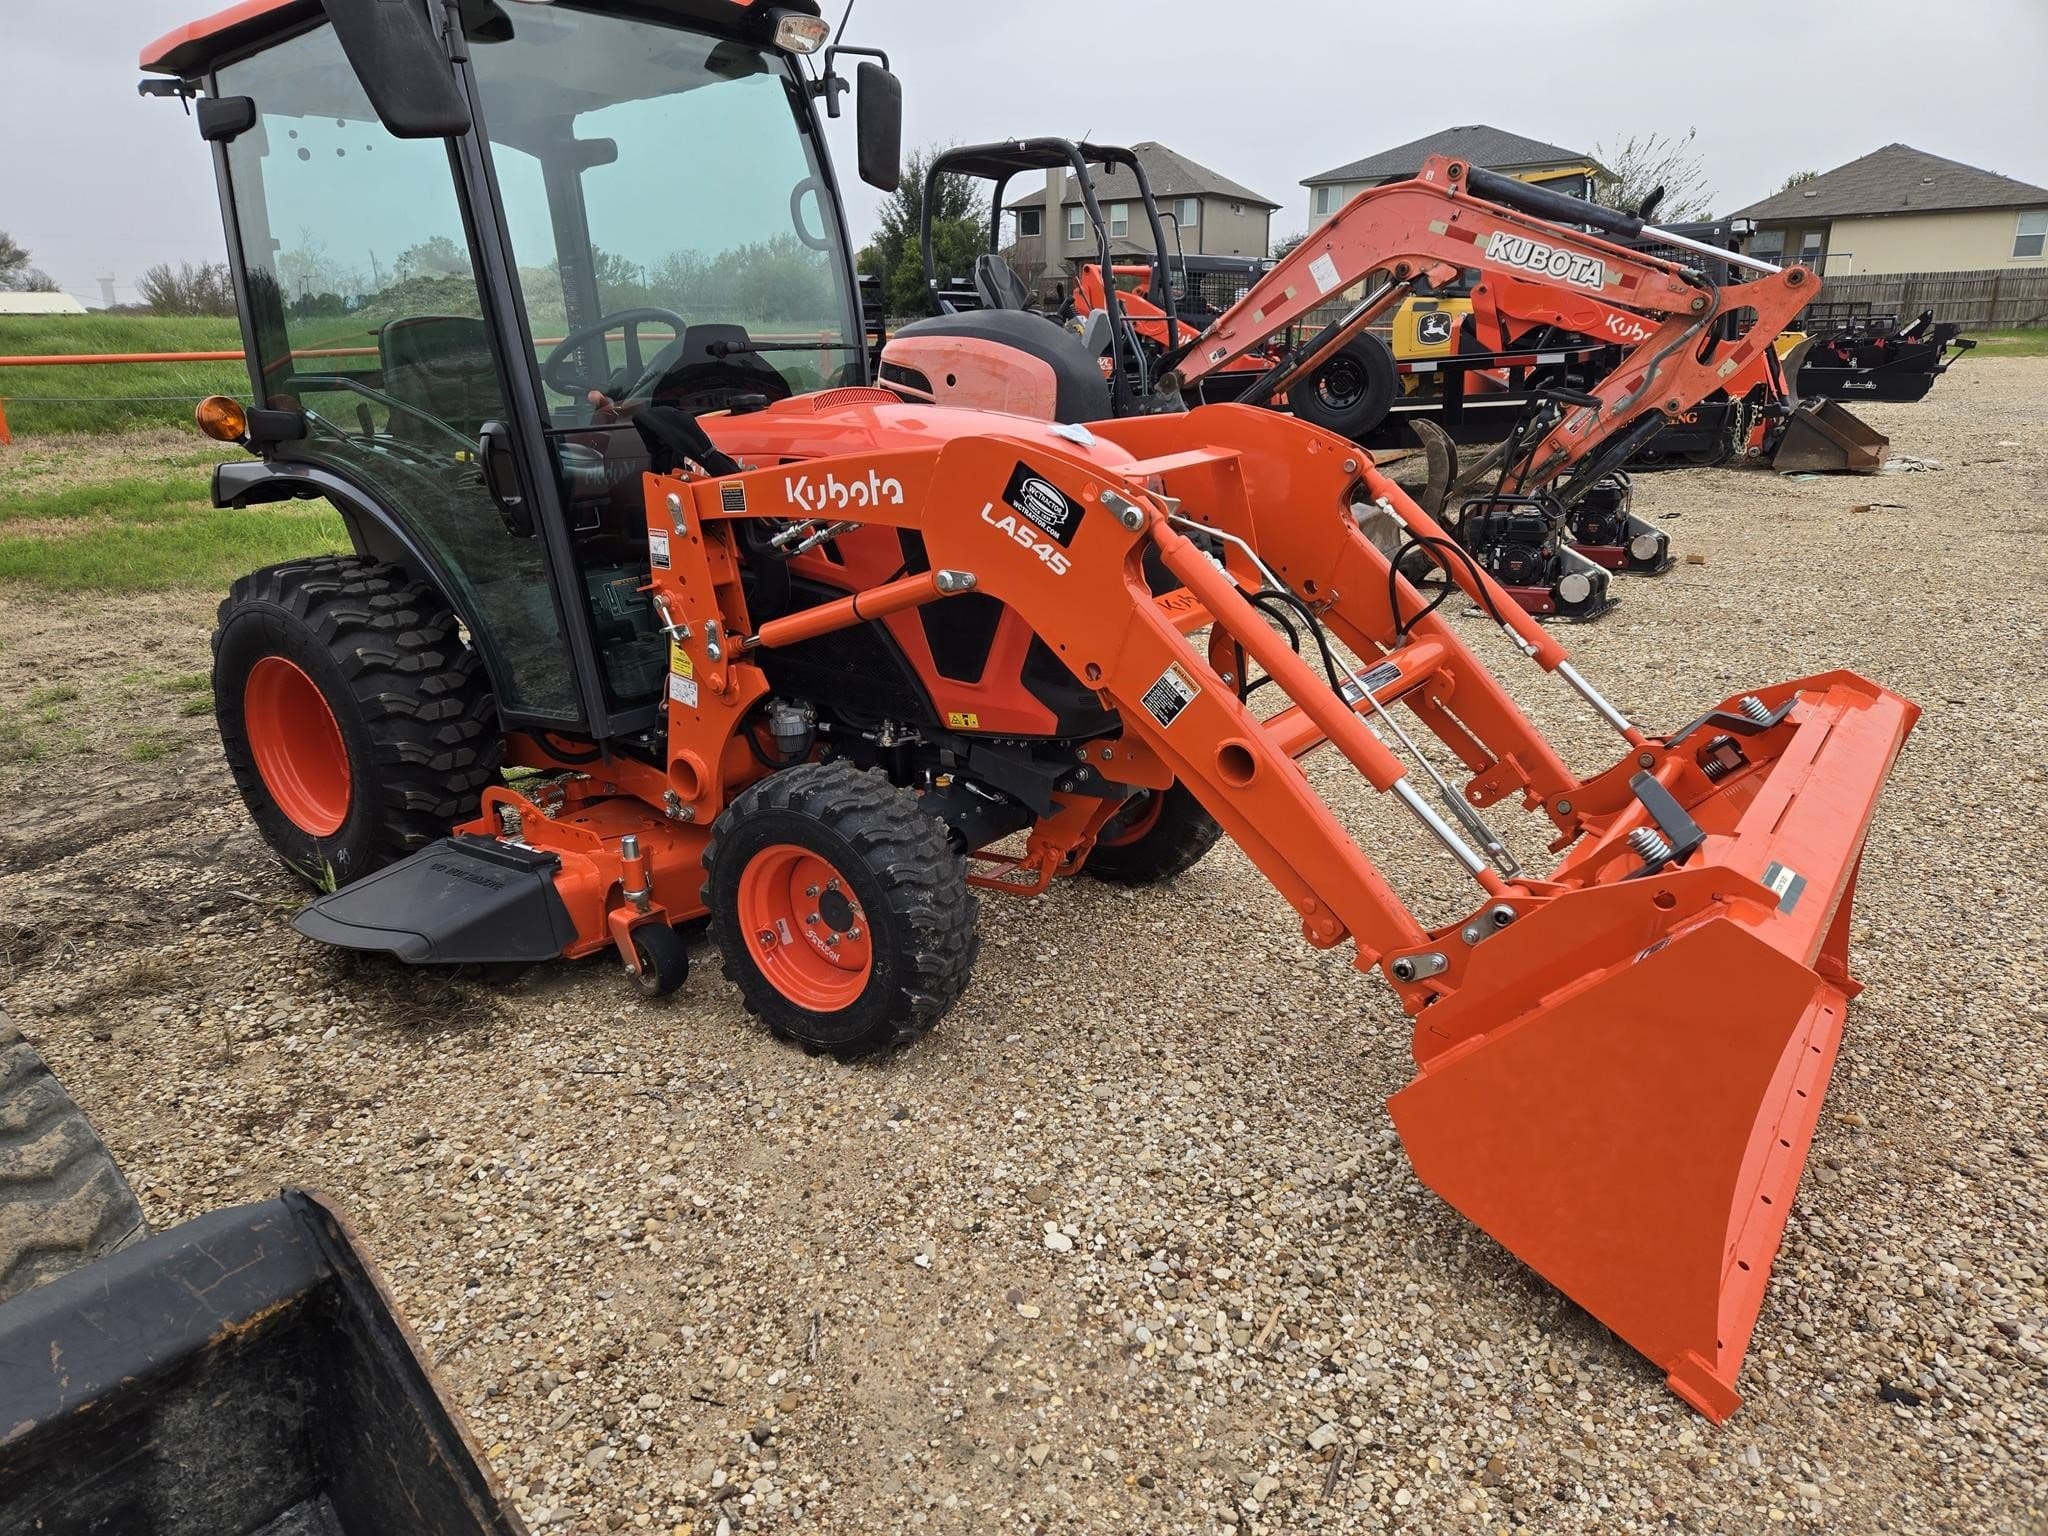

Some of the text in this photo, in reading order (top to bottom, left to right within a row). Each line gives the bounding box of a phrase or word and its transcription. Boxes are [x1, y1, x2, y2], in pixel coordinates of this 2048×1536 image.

[1486, 231, 1605, 290] KUBOTA
[785, 469, 904, 511] Kubota
[1028, 485, 1063, 516] WCTRACTOR
[981, 502, 1072, 575] LA545
[1012, 500, 1061, 540] WCTRACTOR.COM
